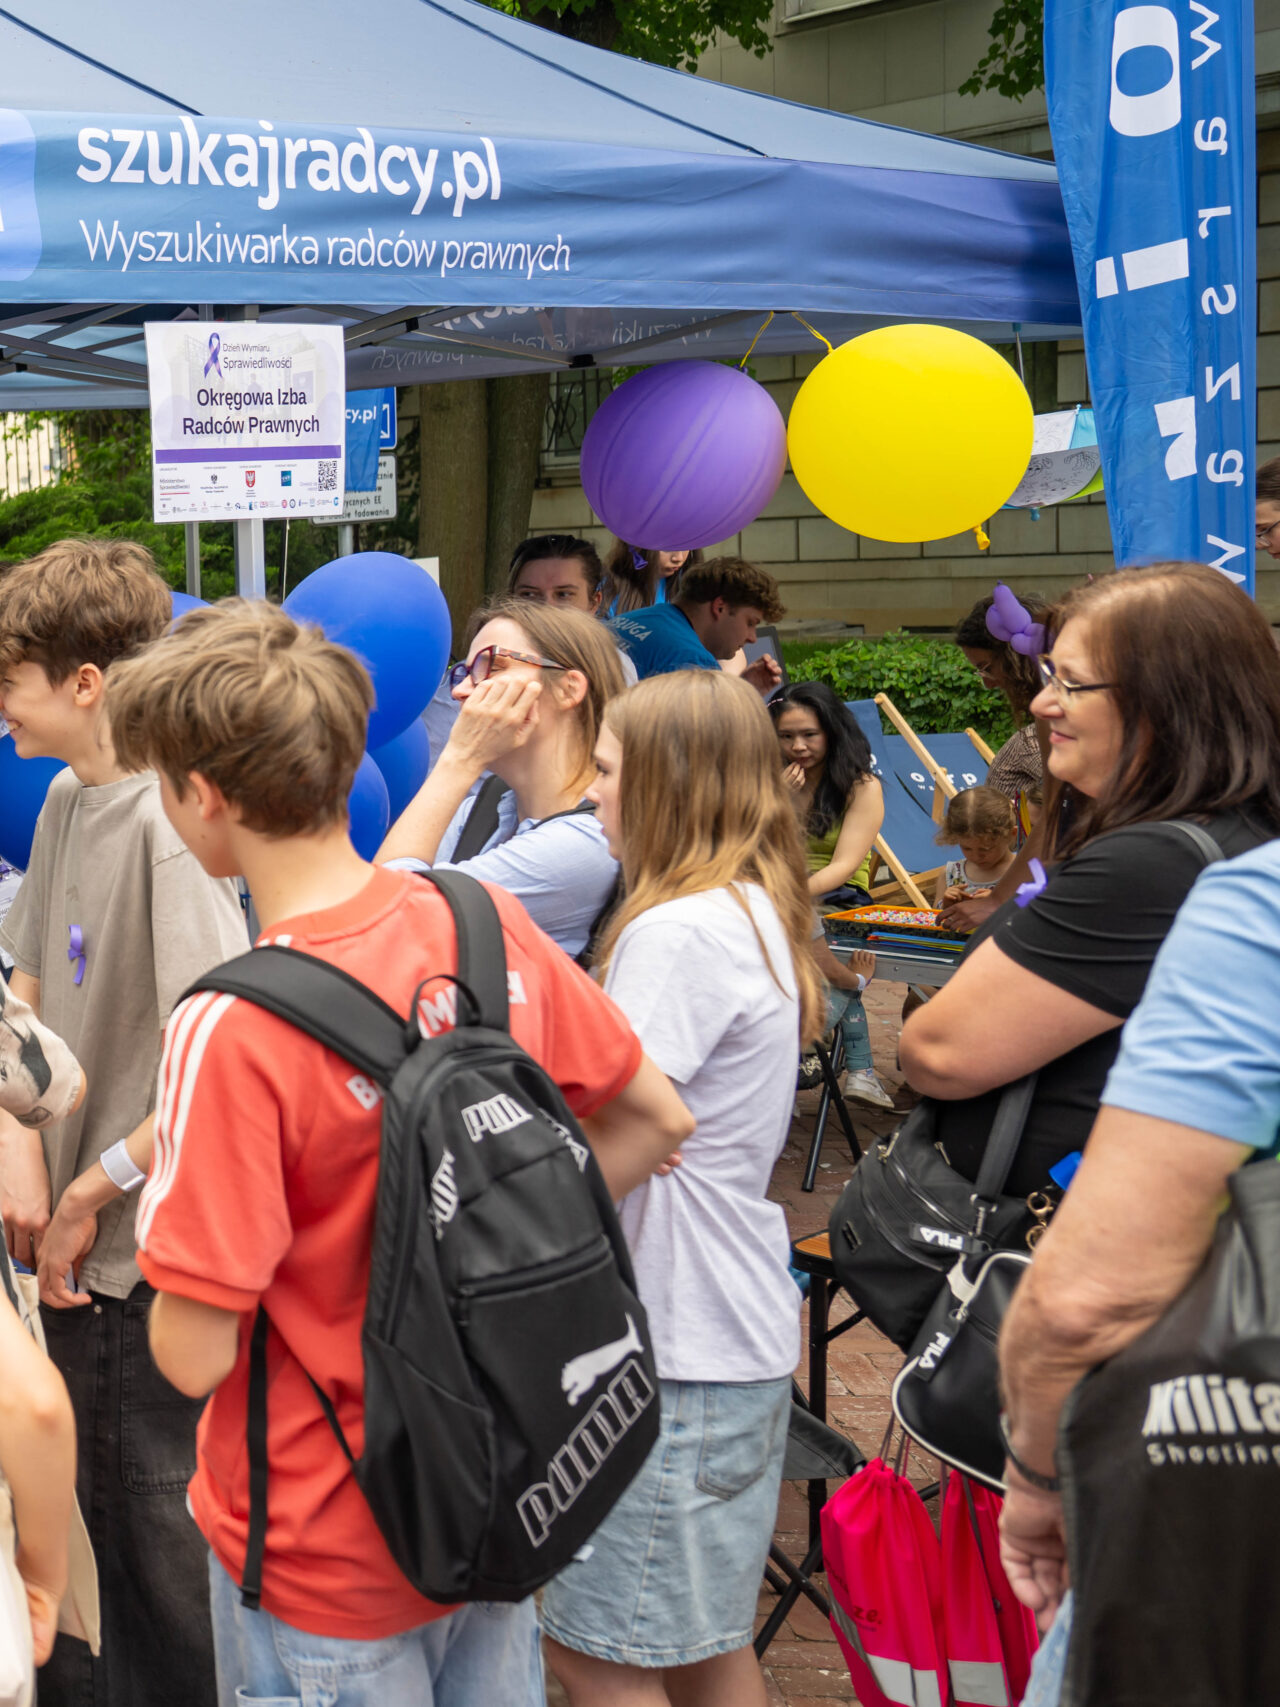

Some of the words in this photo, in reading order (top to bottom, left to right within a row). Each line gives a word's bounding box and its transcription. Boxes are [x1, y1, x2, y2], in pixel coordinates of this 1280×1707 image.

[76, 115, 502, 218] szukajradcy.pl
[78, 218, 319, 272] Wyszukiwarka
[327, 227, 437, 268] radców
[440, 234, 571, 280] prawnych
[222, 343, 241, 353] Dzień
[241, 343, 270, 355] Wymiaru
[223, 356, 293, 371] Sprawiedliwości
[197, 387, 274, 411] Okręgowa
[277, 387, 308, 406] Izba
[182, 415, 245, 435] Radców
[248, 414, 321, 437] Prawnych
[920, 1226, 964, 1251] FILA
[919, 1331, 952, 1370] FILA
[515, 1357, 656, 1549] PUMA
